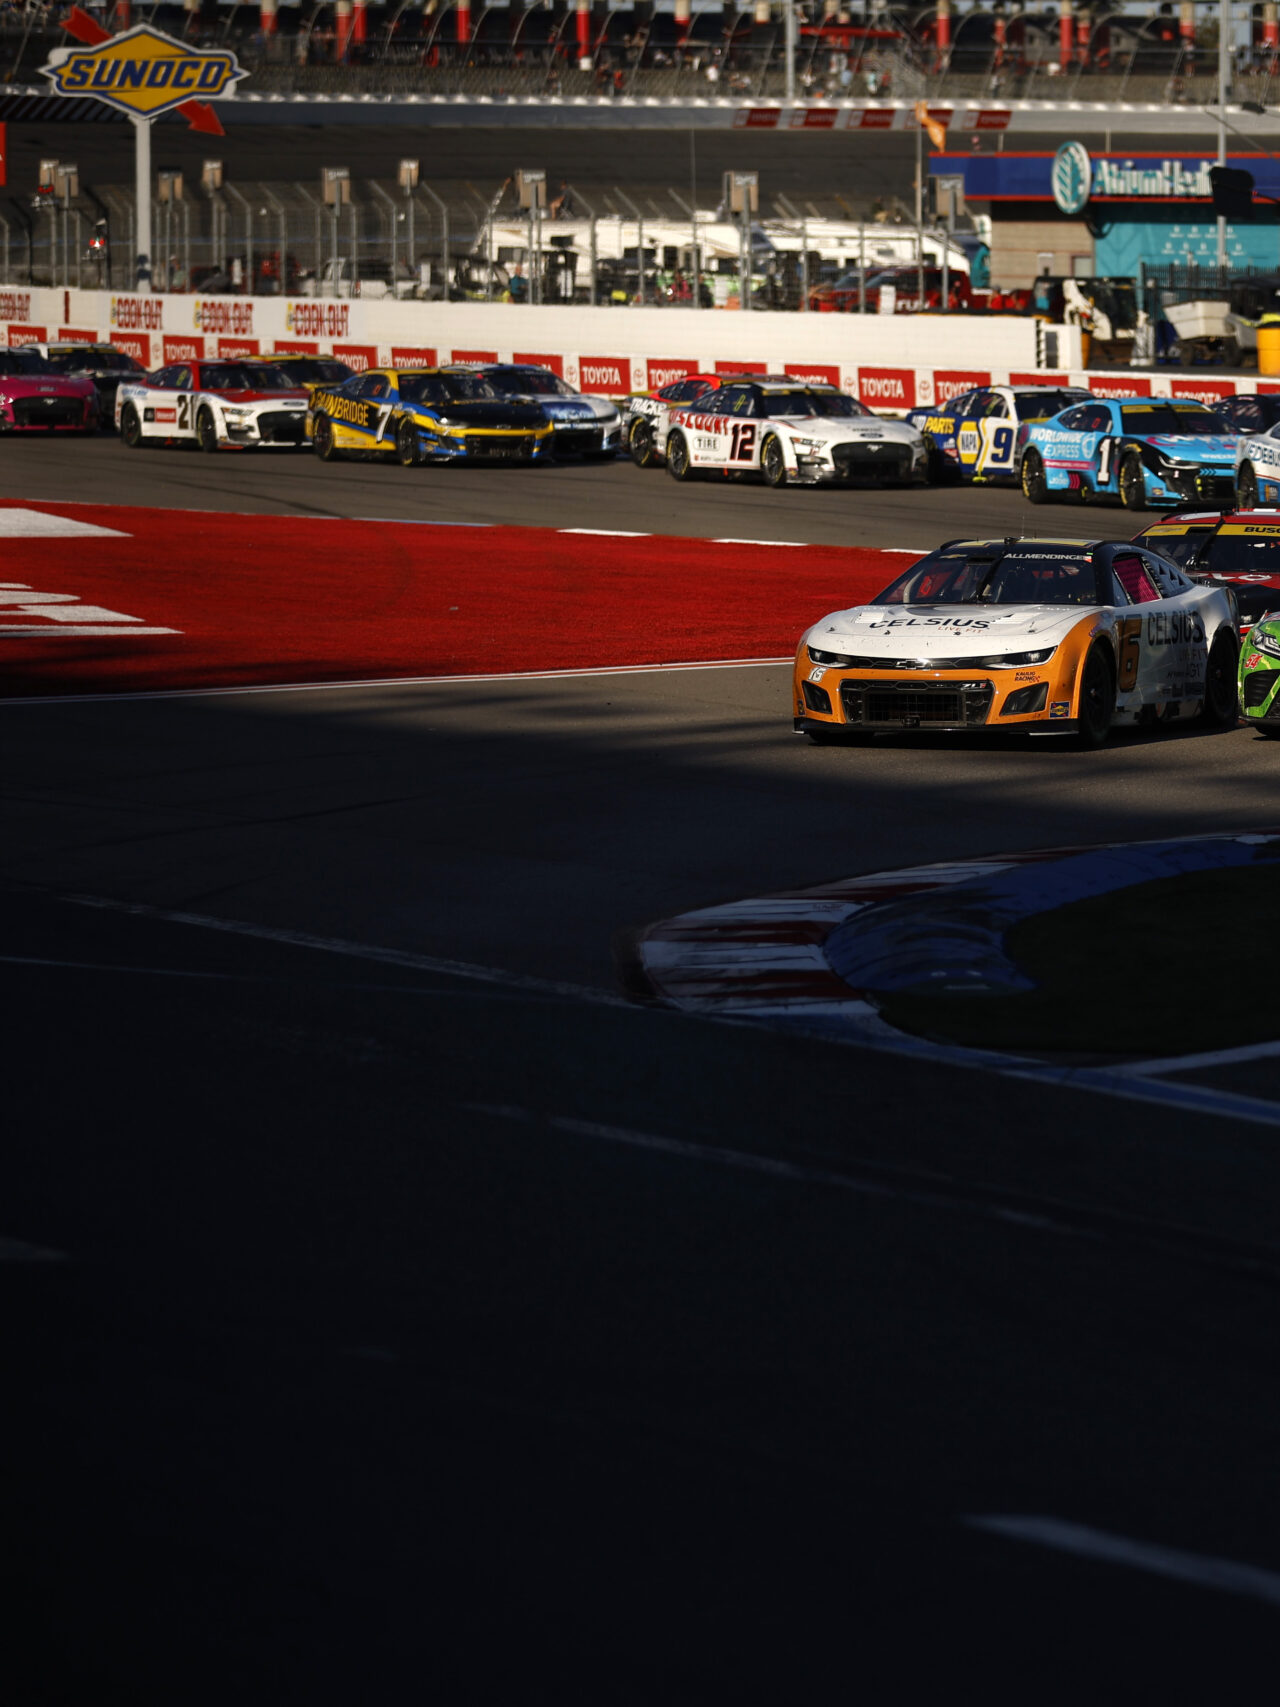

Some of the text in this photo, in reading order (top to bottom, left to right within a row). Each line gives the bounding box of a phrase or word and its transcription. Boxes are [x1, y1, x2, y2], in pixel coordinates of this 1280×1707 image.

[65, 59, 226, 88] SUNOCO
[582, 366, 622, 385] TOYOTA
[861, 378, 904, 398] TOYOTA
[376, 403, 393, 443] 7
[669, 410, 729, 436] DISCOUNT
[924, 416, 956, 434] PARTS
[697, 438, 718, 449] TIRE
[729, 423, 757, 461] 12
[961, 432, 977, 452] NAPA
[991, 427, 1014, 463] 9
[1030, 428, 1083, 443] WORLDWIDE
[1043, 444, 1080, 458] EXPRESS
[1098, 438, 1111, 482] 1
[1003, 552, 1085, 560] ALLMENDINGE
[869, 618, 990, 629] CELSIUS
[1148, 611, 1204, 646] CELSIUS
[1245, 653, 1263, 670] 54
